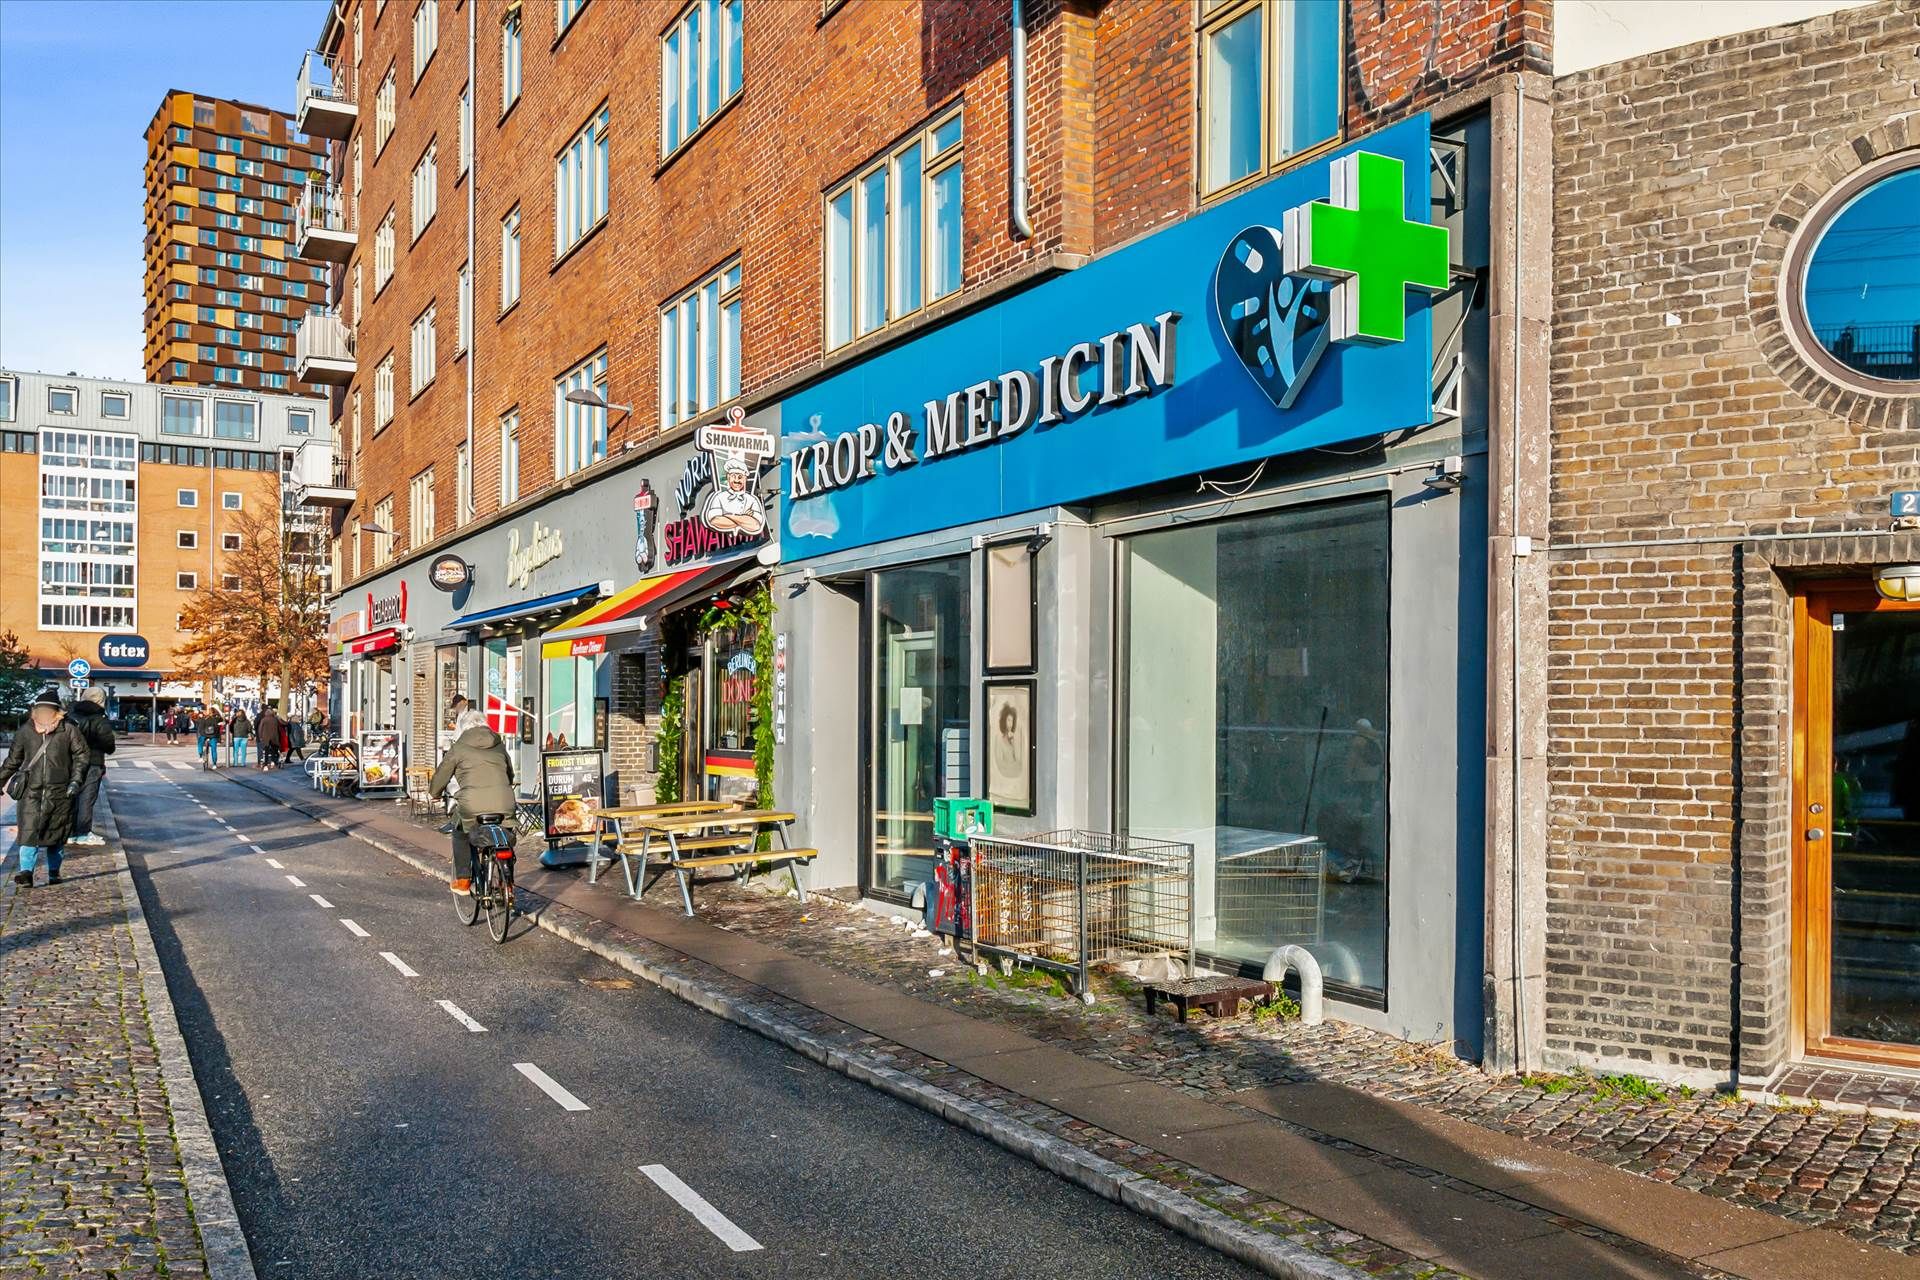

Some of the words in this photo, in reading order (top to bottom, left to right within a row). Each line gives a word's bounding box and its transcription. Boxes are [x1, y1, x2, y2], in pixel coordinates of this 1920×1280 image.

[789, 423, 882, 501] KROP
[883, 411, 918, 470] &
[924, 311, 1182, 459] MEDICIN
[705, 432, 770, 452] SHAWARMA
[1903, 494, 1916, 513] 2
[664, 515, 765, 562] SHAWA
